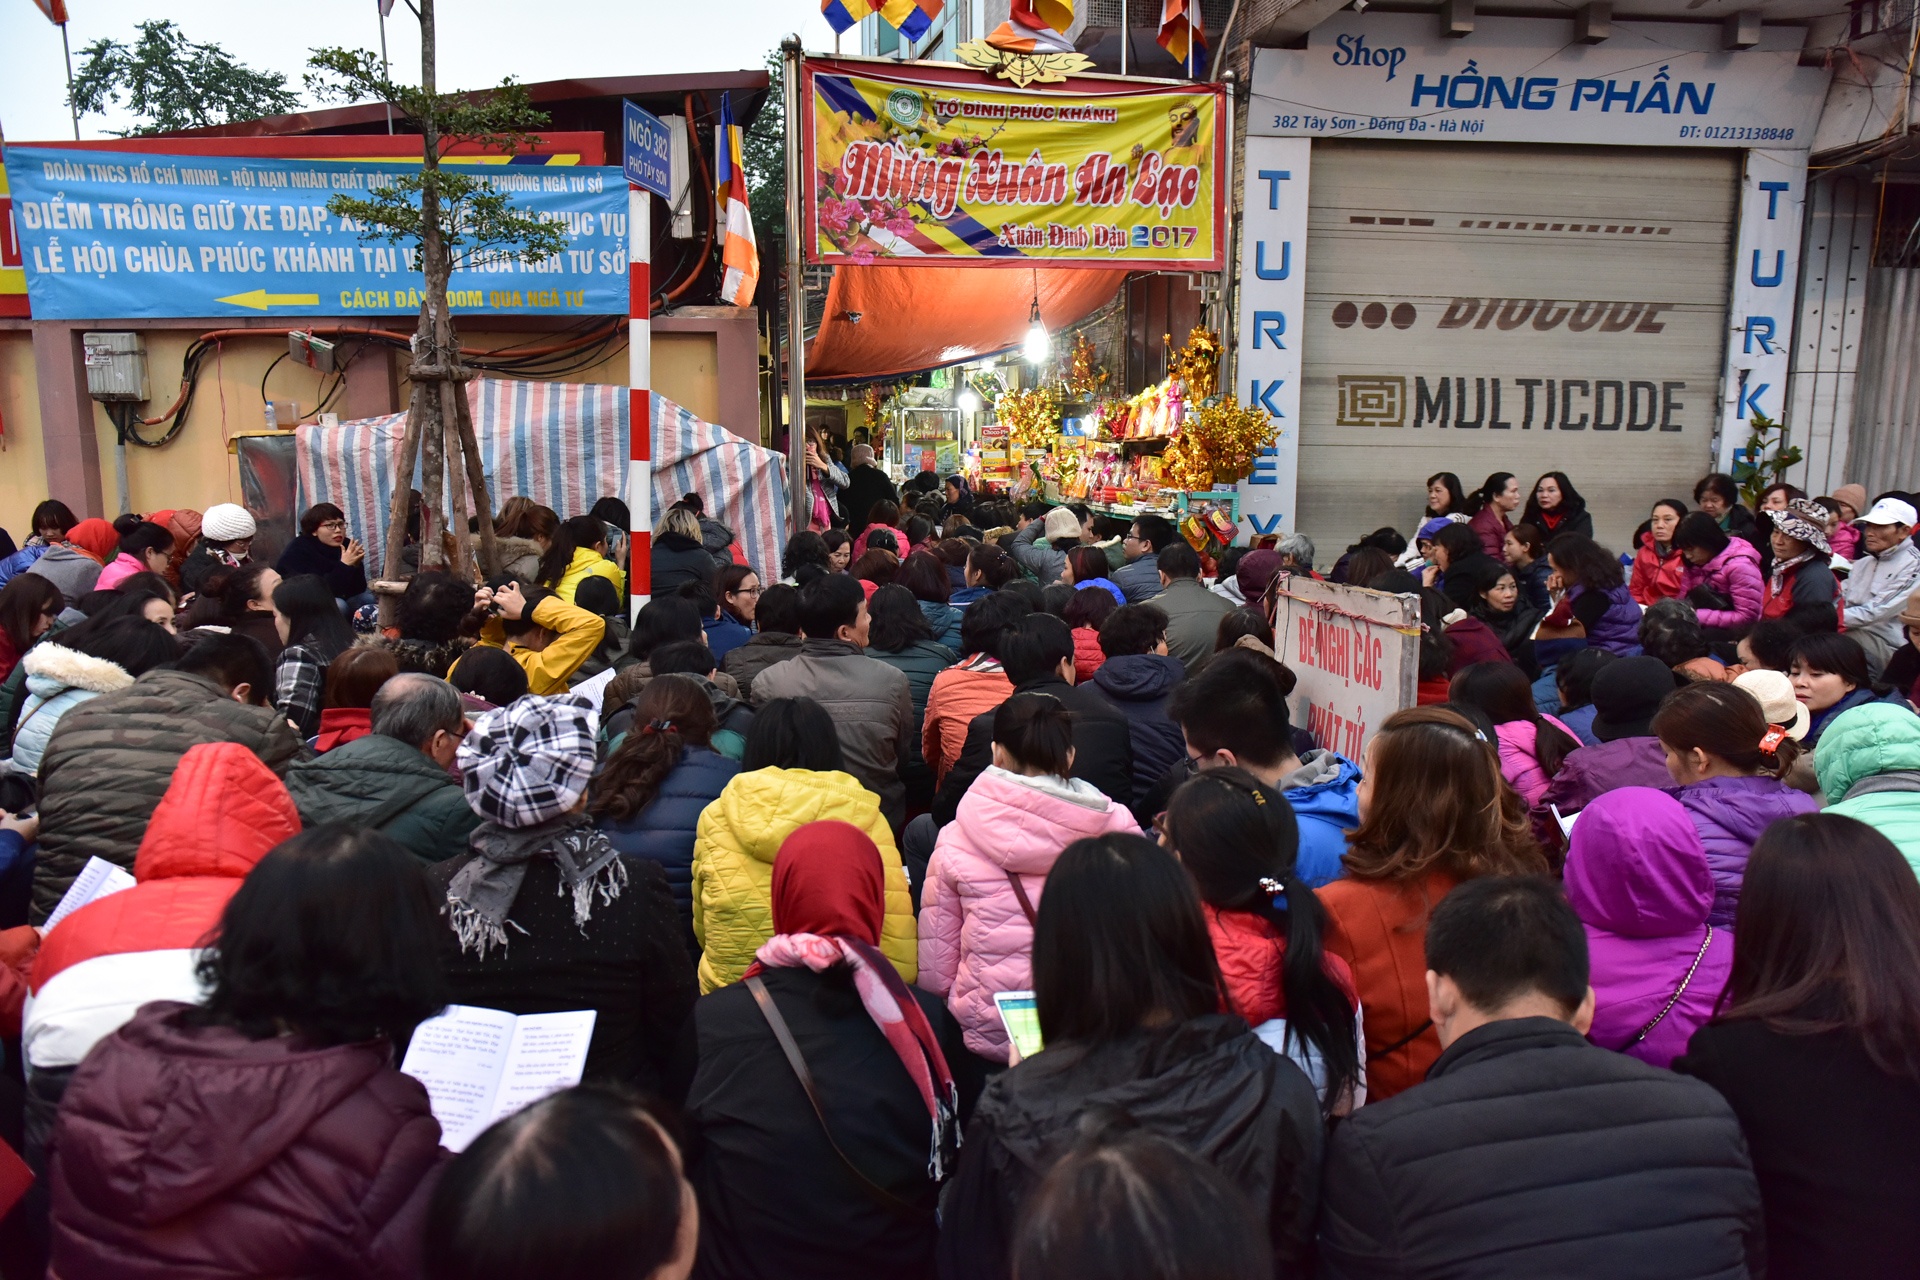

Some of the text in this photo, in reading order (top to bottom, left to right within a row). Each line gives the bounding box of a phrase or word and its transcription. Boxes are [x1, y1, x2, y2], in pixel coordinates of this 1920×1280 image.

[1332, 34, 1406, 82] Shop
[1411, 59, 1715, 115] HỒNG PHẤN
[936, 99, 959, 117] TỔ
[962, 98, 1005, 118] ĐÌNH
[1008, 102, 1055, 121] PHÚC
[1058, 103, 1118, 122] KHÁNH
[1272, 115, 1298, 129] 382
[1302, 115, 1327, 131] Tây
[1331, 117, 1356, 130] Sơn
[1369, 115, 1405, 133] Đống
[1409, 118, 1427, 132] Đa
[1439, 119, 1457, 132] Hà
[1460, 119, 1485, 135] Nội
[629, 117, 668, 161] NGÕ 382
[1680, 125, 1795, 141] ĐT: 01213138848
[43, 159, 85, 182] ĐOÀN
[87, 164, 127, 183] TNCS
[130, 161, 150, 184] HỒ
[153, 164, 179, 185] CHÍ
[181, 168, 220, 186] MINH
[231, 170, 255, 190] HỘI
[258, 171, 287, 191] NẠN
[291, 169, 328, 189] NHÂN
[331, 167, 364, 189] CHẤT
[492, 173, 540, 193] PHƯỜNG
[543, 173, 568, 193] NGÃ
[570, 175, 586, 193] TƯ
[588, 171, 603, 194] SỞ
[629, 152, 667, 187] PHỐ TÂY SƠN
[843, 139, 965, 219] Mừng
[966, 148, 1066, 205] Xuân
[1074, 153, 1127, 207] An
[23, 192, 93, 230] ĐIỂM
[98, 197, 186, 231] TRÔNG
[192, 200, 236, 231] GIỮ
[243, 205, 274, 231] XE
[280, 205, 332, 237] ĐẠP,
[538, 211, 594, 241] PHỤC
[600, 213, 626, 242] VỤ
[998, 223, 1043, 248] Xuân
[1092, 225, 1127, 253] Dậu
[1131, 225, 1198, 248] 2017
[33, 236, 65, 273] LỄ
[73, 241, 117, 279] HỘI
[125, 240, 194, 273] CHÙA
[199, 241, 266, 273] PHÚC
[273, 241, 355, 273] KHÁNH
[360, 247, 397, 279] TẠI
[568, 248, 595, 275] TƯ
[599, 243, 626, 275] SỞ
[340, 287, 389, 308] CÁCH
[489, 290, 523, 309] QUA
[527, 288, 563, 308] NGÃ
[564, 289, 585, 308] TƯ
[1246, 171, 1291, 534] TURKEY
[1413, 376, 1686, 432] MULTICODE
[1319, 622, 1349, 688] NGHỊ
